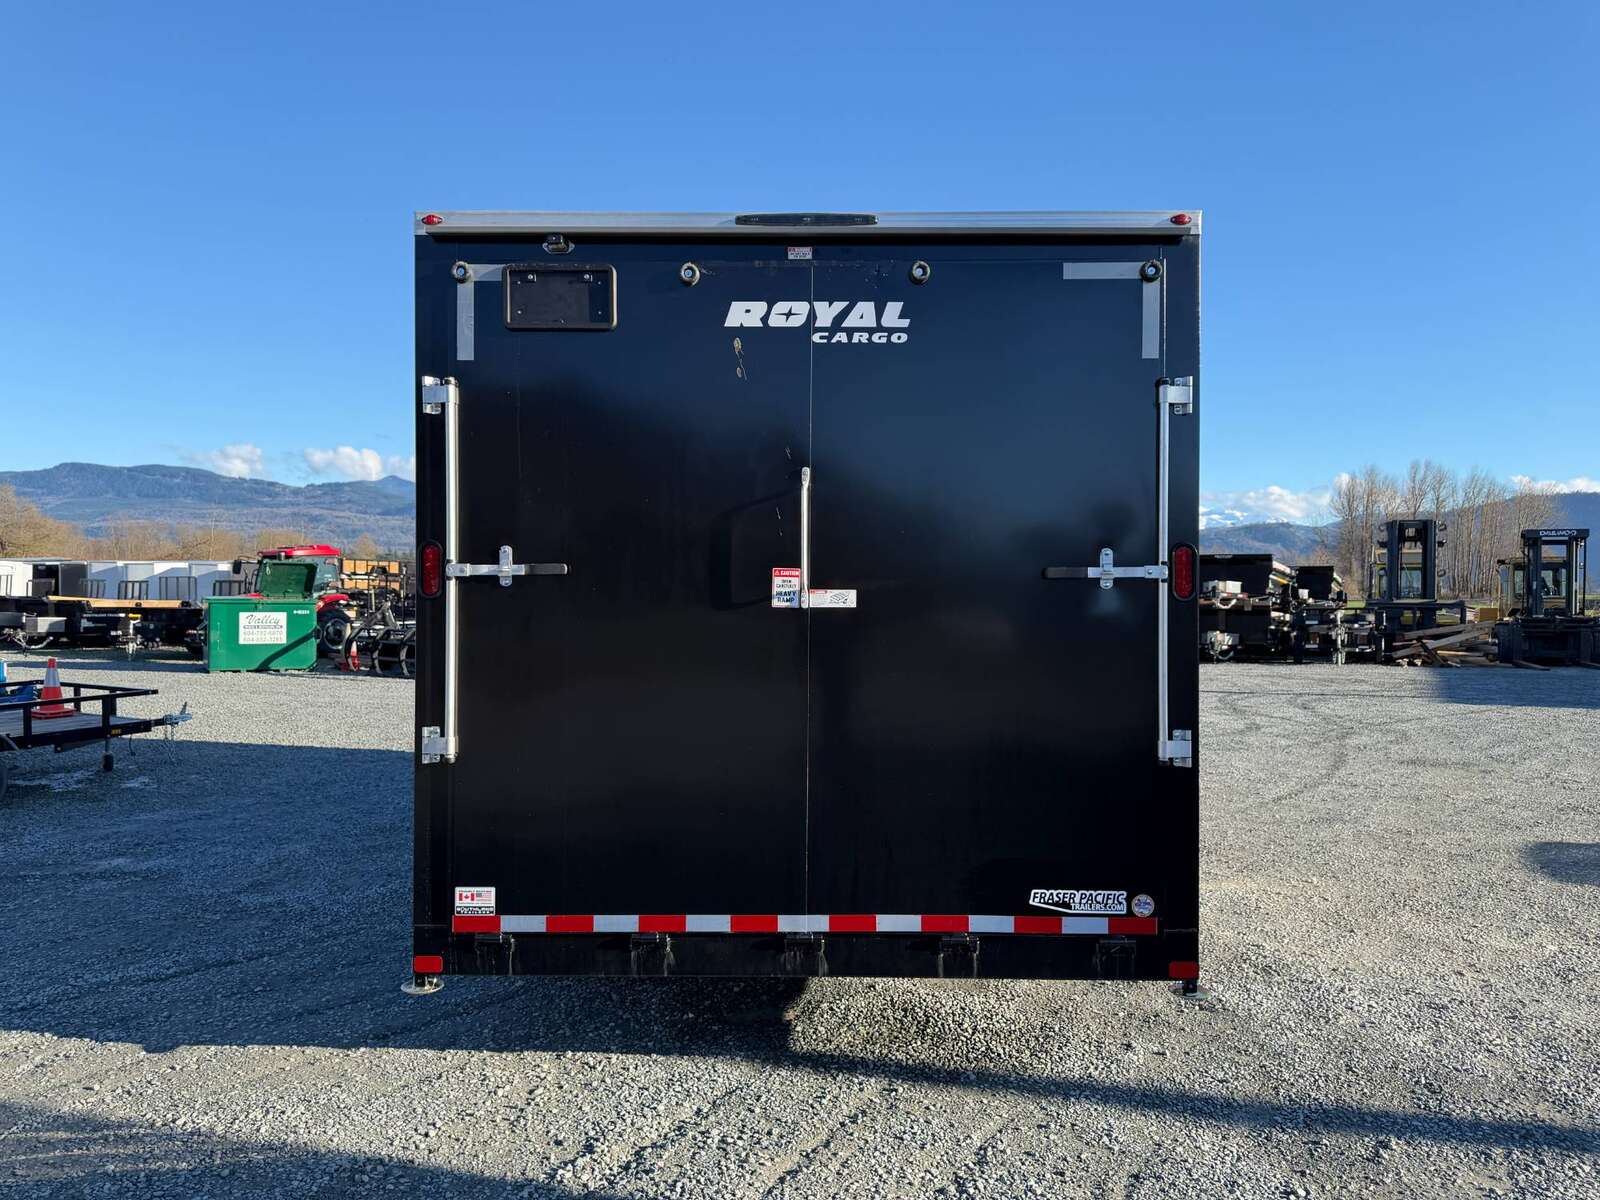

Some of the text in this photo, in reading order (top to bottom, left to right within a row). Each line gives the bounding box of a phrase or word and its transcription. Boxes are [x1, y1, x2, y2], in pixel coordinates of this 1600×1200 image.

[723, 301, 911, 328] ROYAL
[811, 332, 908, 344] CARGO
[245, 614, 281, 625] Valley
[1031, 890, 1125, 904] FRASER PACIFIC
[1071, 903, 1124, 911] TRAILERS.COM
